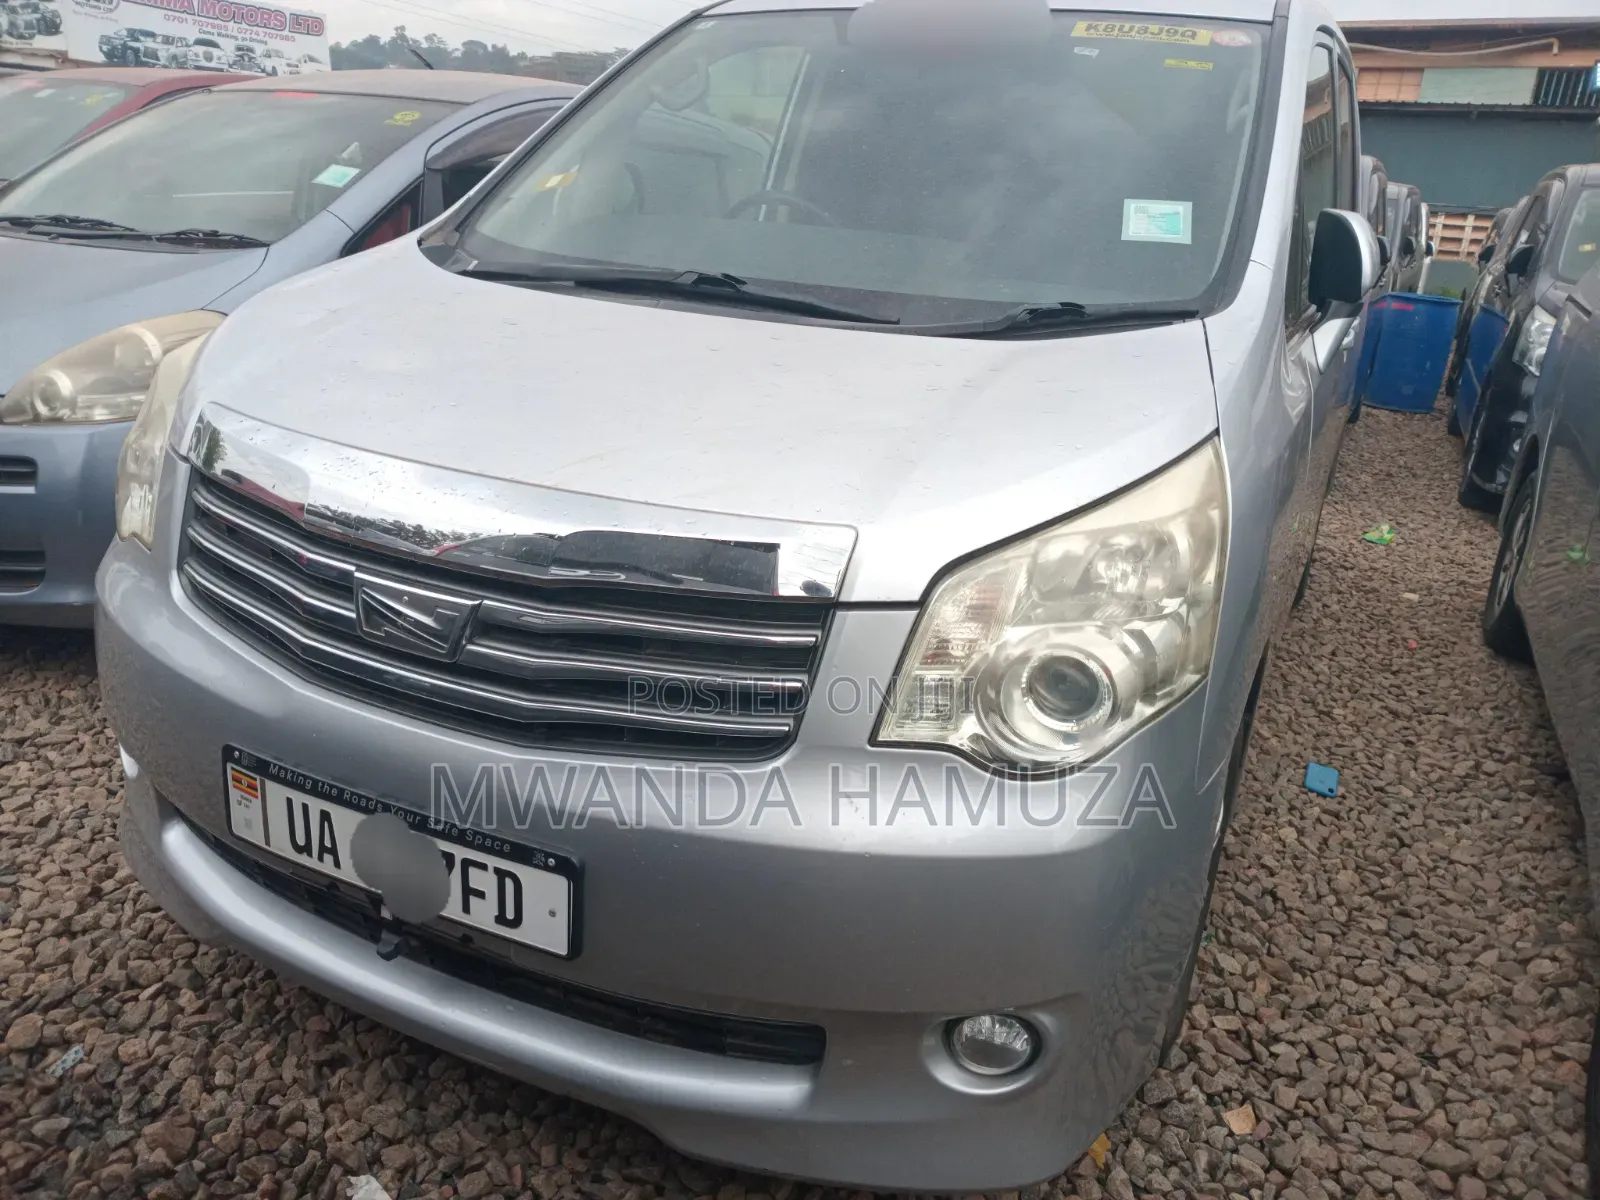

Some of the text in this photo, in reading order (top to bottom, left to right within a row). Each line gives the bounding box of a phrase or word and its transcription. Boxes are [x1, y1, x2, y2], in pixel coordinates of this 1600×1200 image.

[163, 13, 188, 25] 0701
[197, 0, 287, 31] MOTORS
[289, 12, 324, 36] LTD
[1084, 22, 1198, 41] K8U3J9Q
[198, 28, 215, 37] Come
[269, 763, 511, 853] Making the Roads Your Safe Space
[286, 796, 342, 870] UA
